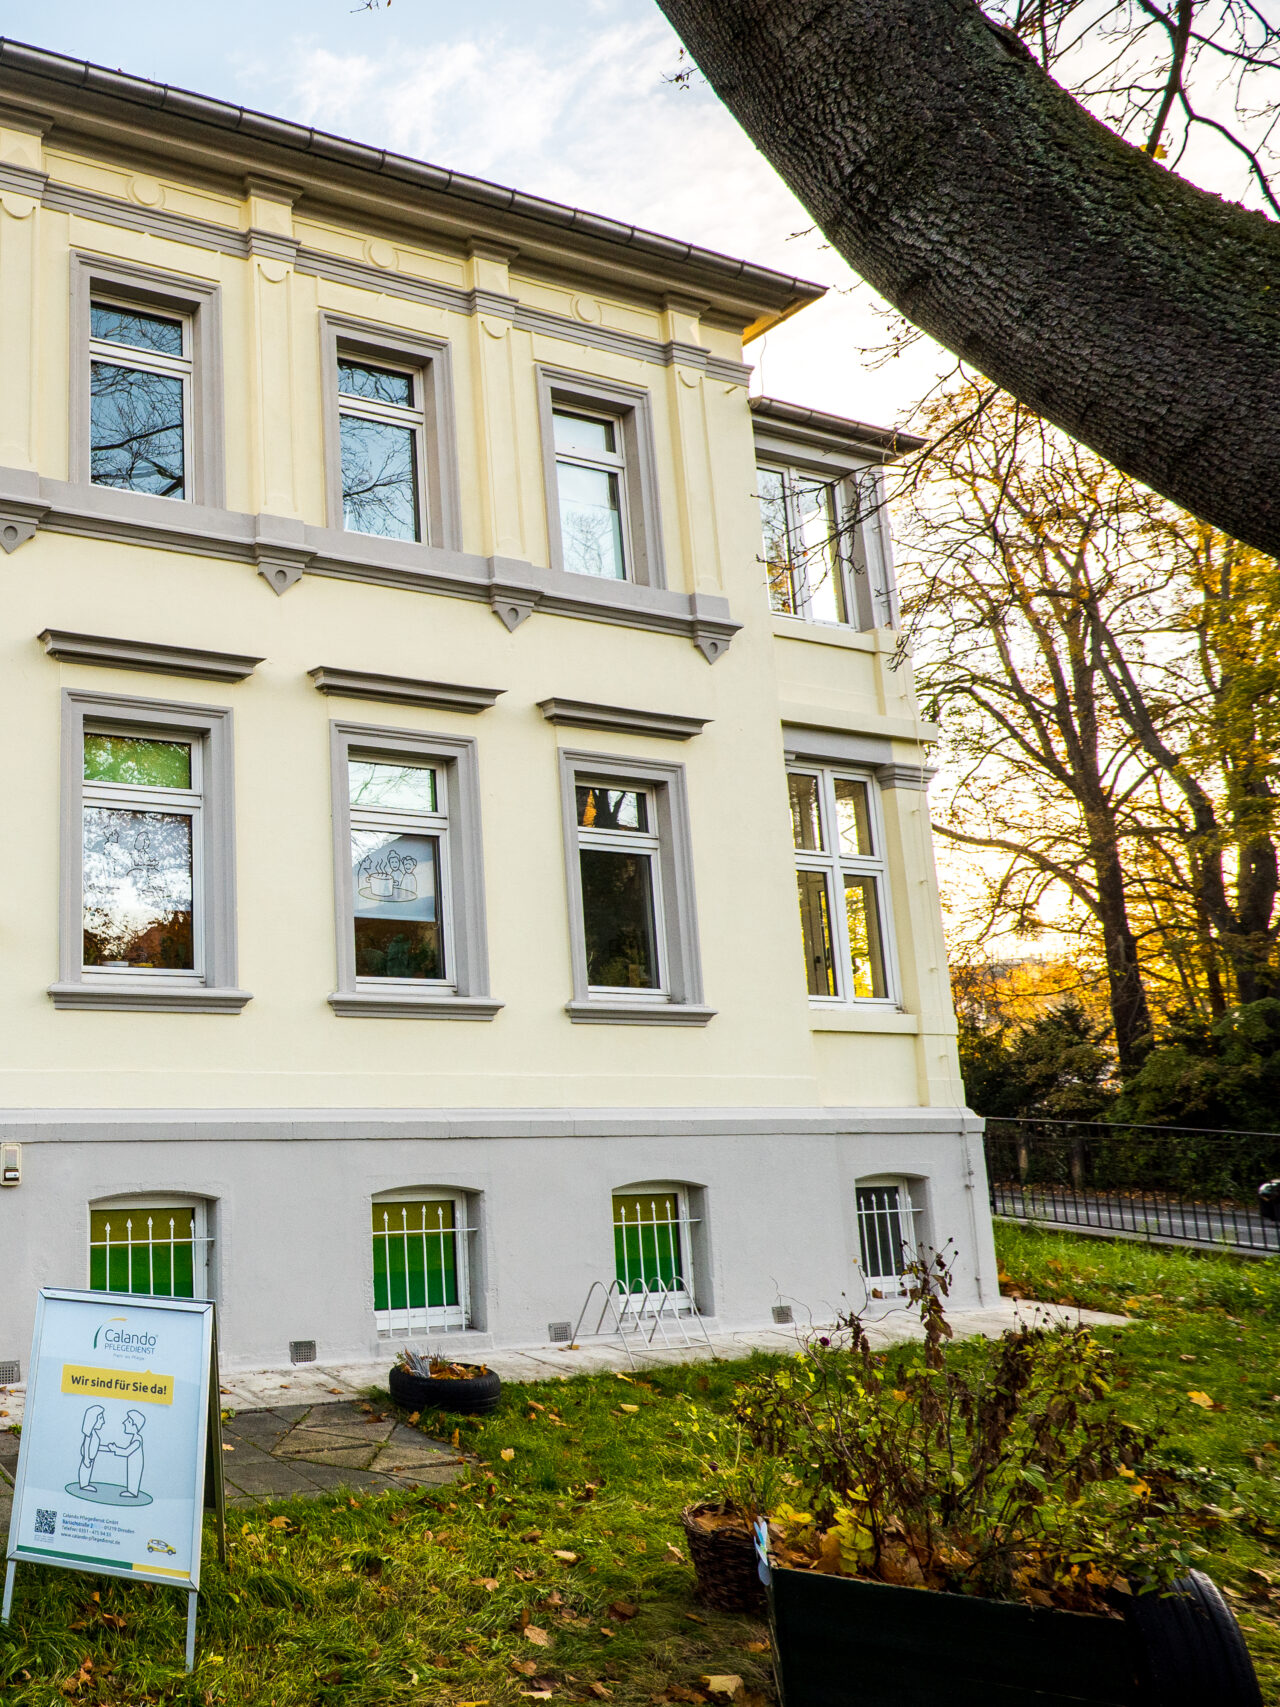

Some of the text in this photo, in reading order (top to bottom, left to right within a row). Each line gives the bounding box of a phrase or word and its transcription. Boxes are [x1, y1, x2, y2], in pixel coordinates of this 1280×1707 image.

[104, 1329, 157, 1346] Calando
[104, 1343, 155, 1355] PFLEGEDIENST
[71, 1375, 167, 1395] Wir sind für Sie da!
